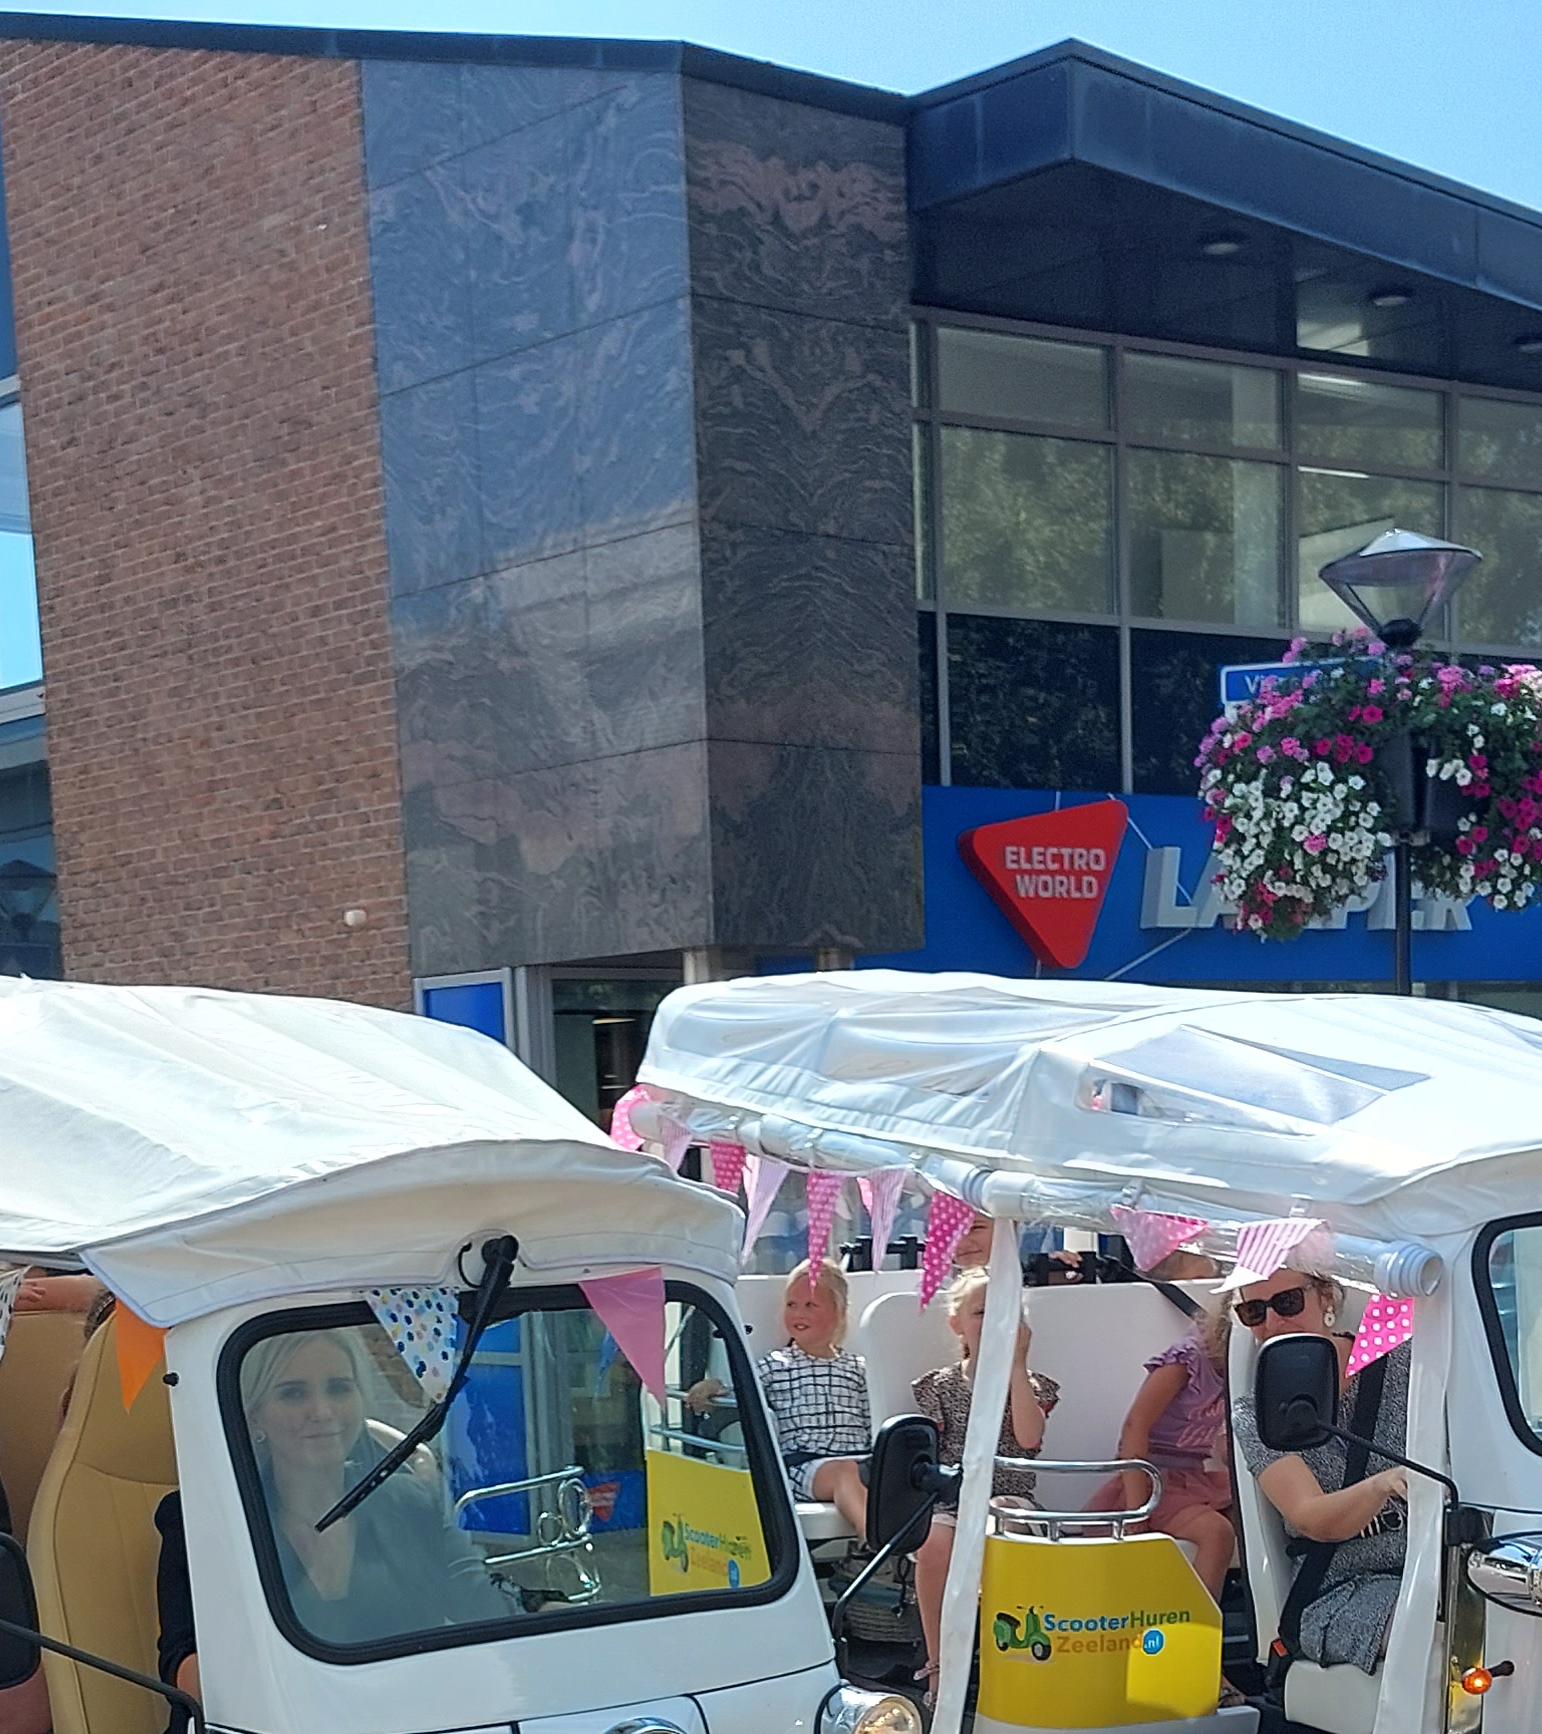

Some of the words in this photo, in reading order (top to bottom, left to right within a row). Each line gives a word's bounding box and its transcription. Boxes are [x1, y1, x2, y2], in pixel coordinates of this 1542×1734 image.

[1004, 845, 1106, 871] ELECTRO
[1015, 874, 1099, 899] WORLD
[1043, 1610, 1191, 1632] ScooterHuren
